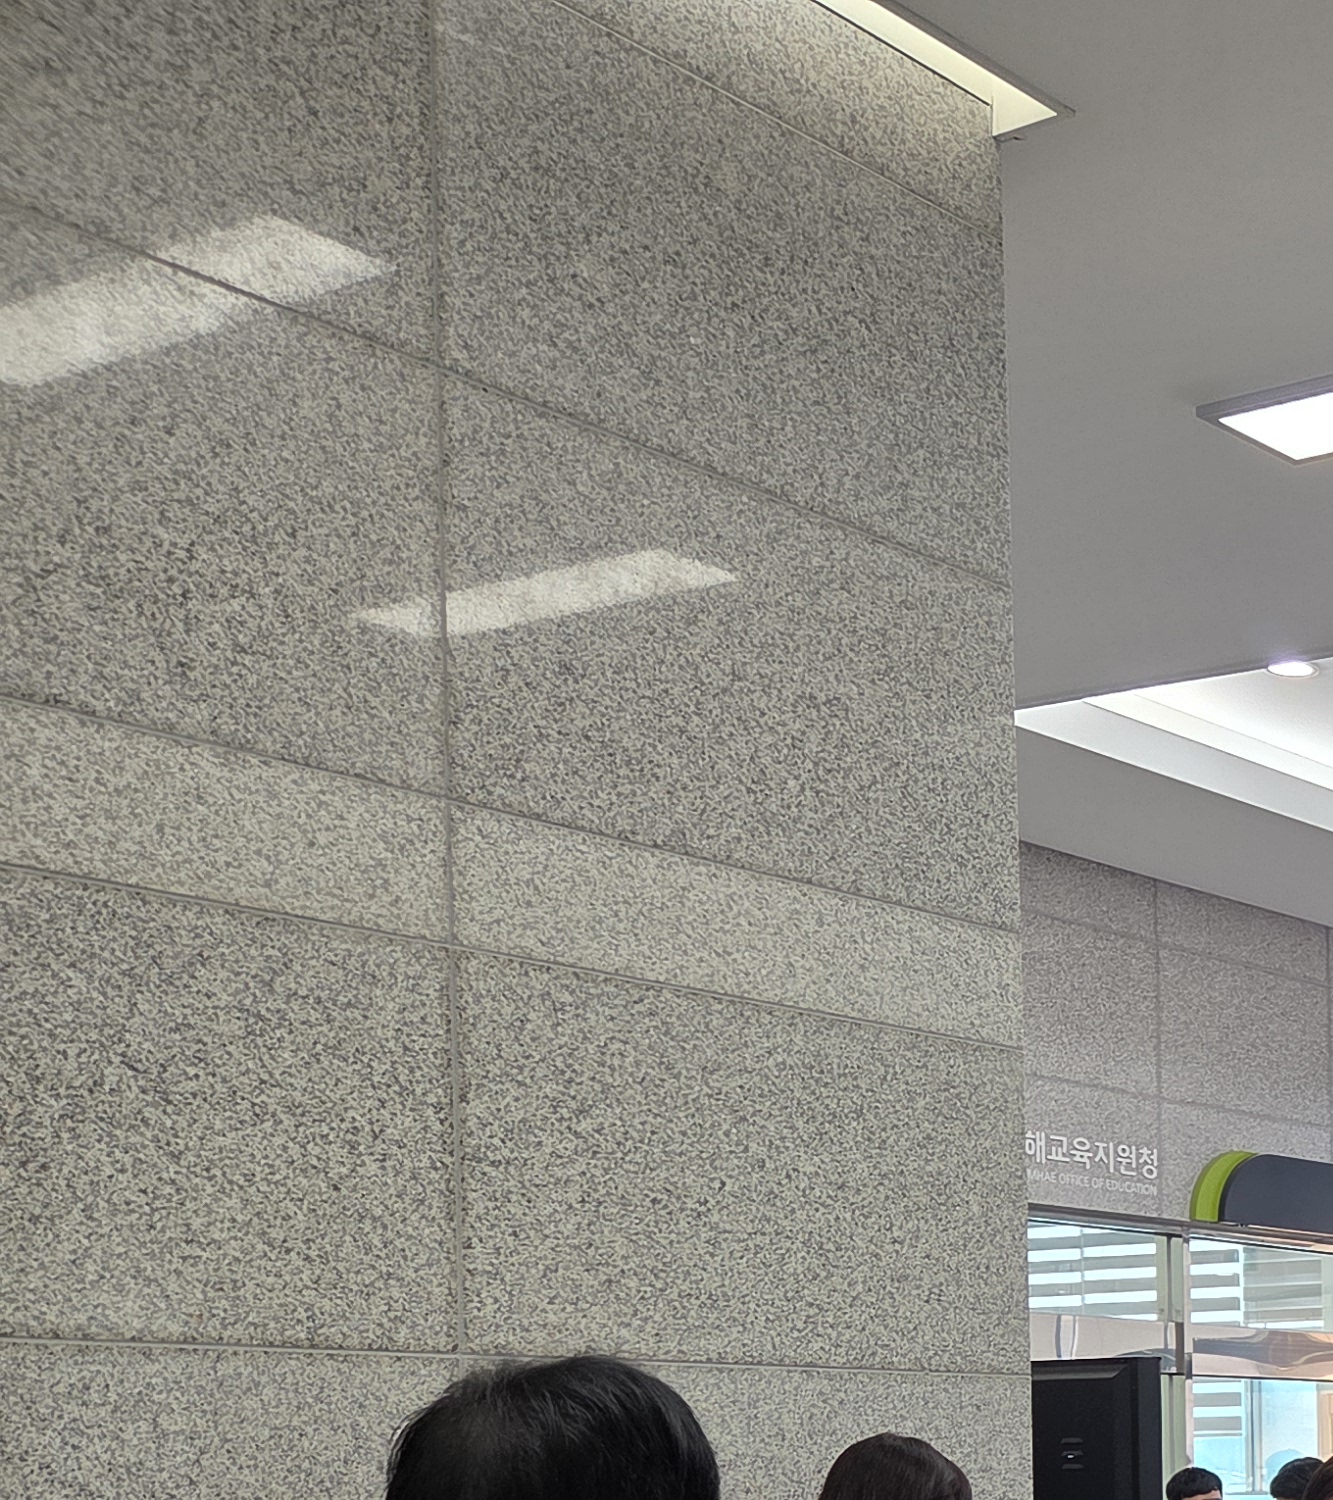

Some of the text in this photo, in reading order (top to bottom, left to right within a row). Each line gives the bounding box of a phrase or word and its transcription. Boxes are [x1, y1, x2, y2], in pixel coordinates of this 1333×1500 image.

[1025, 1130, 1158, 1179] 해교육지원청
[1058, 1172, 1090, 1187] OFFICE
[1091, 1177, 1104, 1189] OF
[1106, 1178, 1158, 1196] EDUCATION
